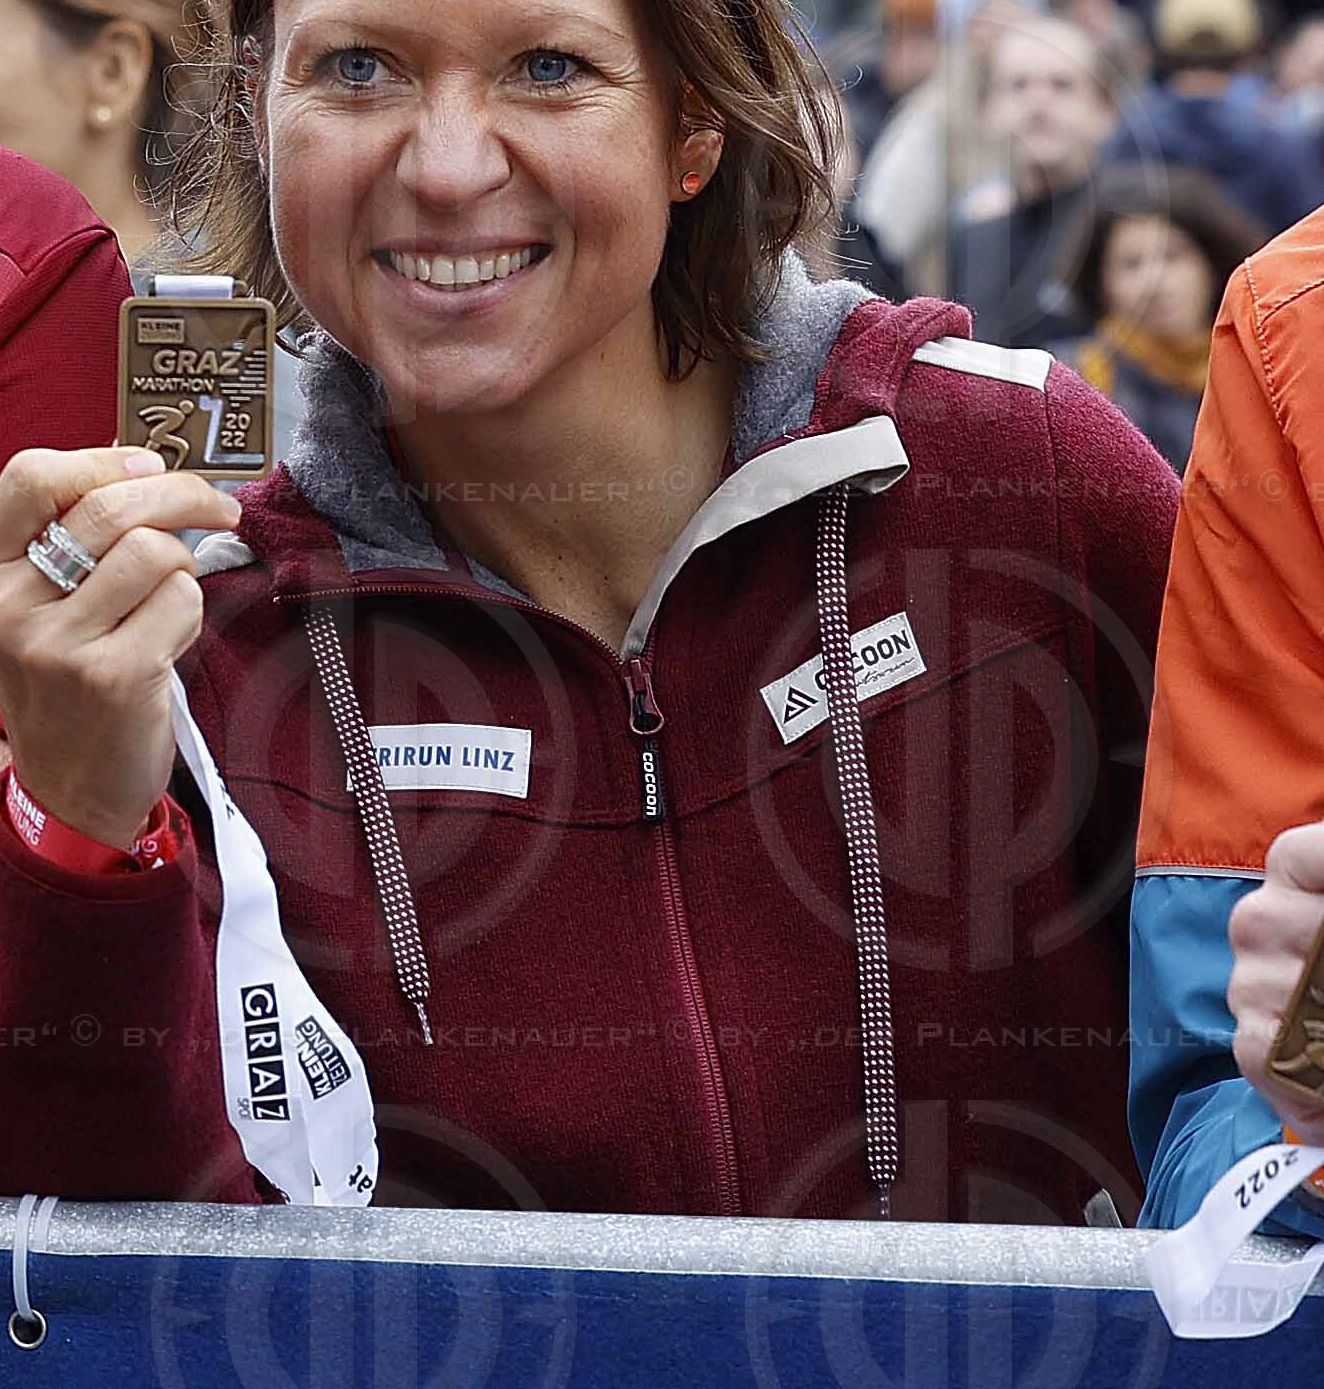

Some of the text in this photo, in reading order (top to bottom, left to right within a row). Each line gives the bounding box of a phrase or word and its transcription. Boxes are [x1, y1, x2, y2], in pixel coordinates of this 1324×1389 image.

[152, 349, 240, 376] GRAZ
[131, 376, 215, 393] MARATHON
[225, 413, 251, 430] 20
[221, 431, 246, 448] 22
[814, 629, 912, 691] COON
[373, 746, 516, 773] RIRUN LINZ
[243, 987, 286, 1118] GRAZ
[301, 1020, 348, 1089] ZEITUNG
[1234, 1149, 1301, 1209] 2022
